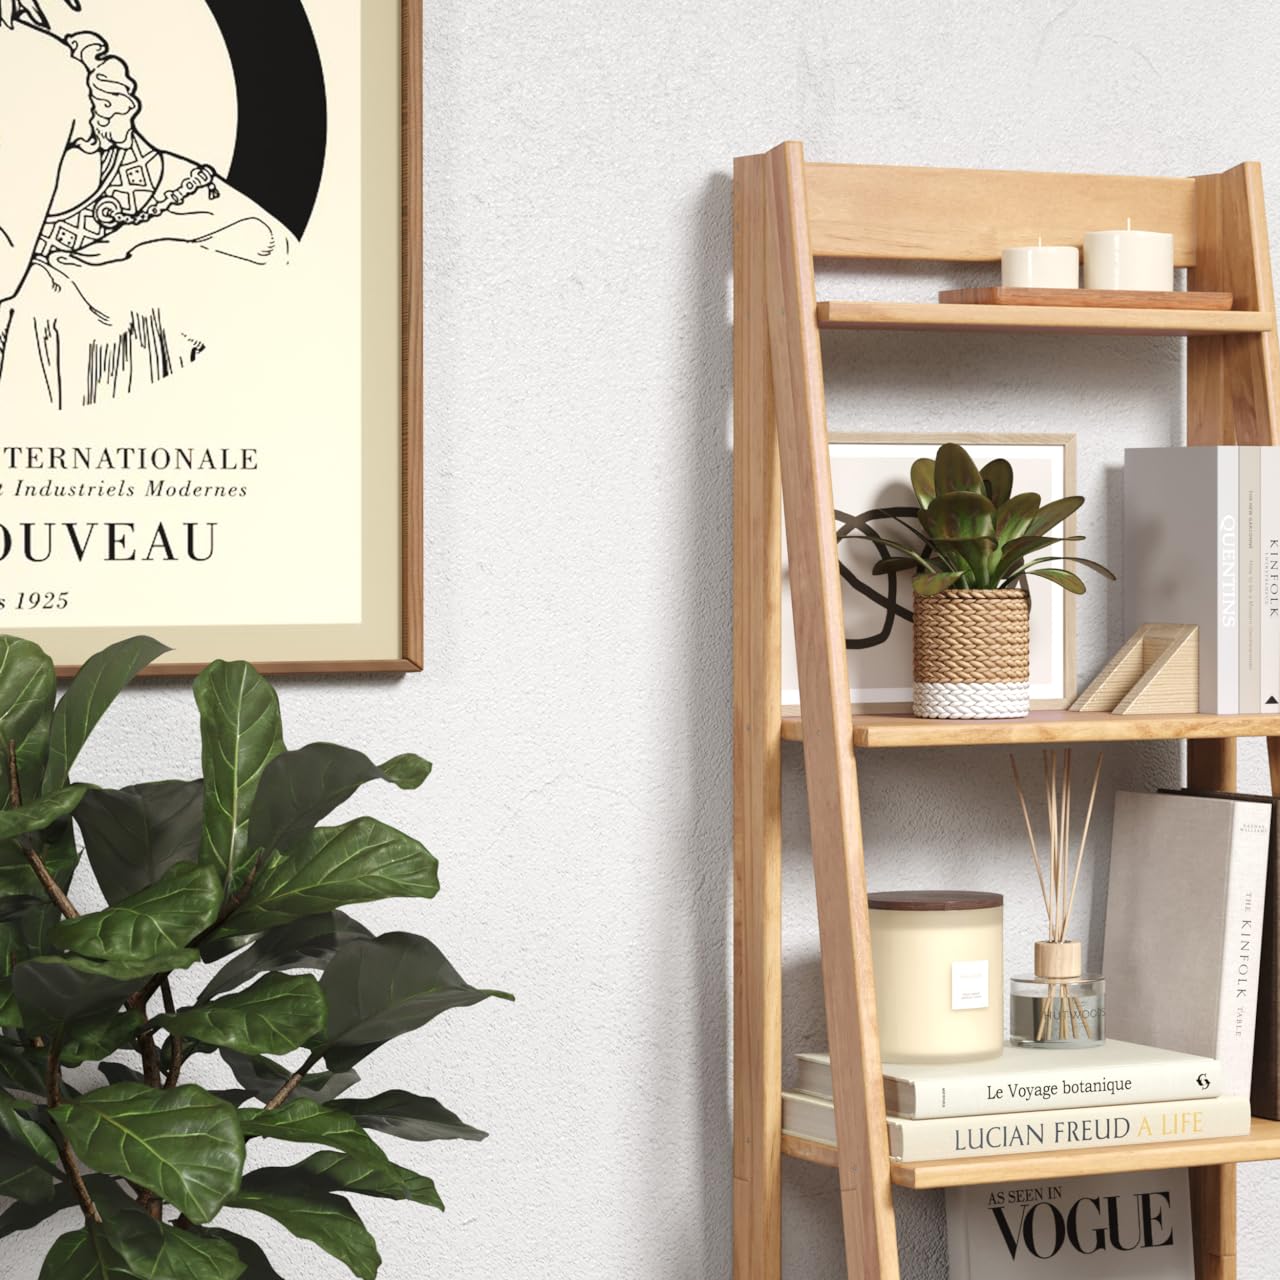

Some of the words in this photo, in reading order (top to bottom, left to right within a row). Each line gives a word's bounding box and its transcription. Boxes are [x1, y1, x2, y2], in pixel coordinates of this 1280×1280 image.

[3, 447, 258, 470] TERNATIONALE
[14, 479, 136, 497] Industriels
[145, 479, 248, 497] Modernes
[1220, 515, 1235, 627] QUENTINS
[1270, 540, 1279, 616] KINFOLK
[15, 591, 70, 610] 1925
[1244, 892, 1252, 912] THE
[1236, 920, 1252, 998] KINFOLK
[1235, 1007, 1244, 1037] TABLE
[987, 1085, 1004, 1100] Le
[1008, 1083, 1059, 1102] Voyage
[1062, 1078, 1132, 1095] botanique
[954, 1123, 1045, 1151] LUCIAN
[1054, 1116, 1131, 1143] FREUD
[1137, 1115, 1153, 1137] A
[1161, 1111, 1203, 1135] LIFE
[988, 1191, 1005, 1206] AS
[1008, 1187, 1044, 1203] SEEN
[1048, 1186, 1062, 1199] IN
[987, 1191, 1174, 1262] VOGUE
